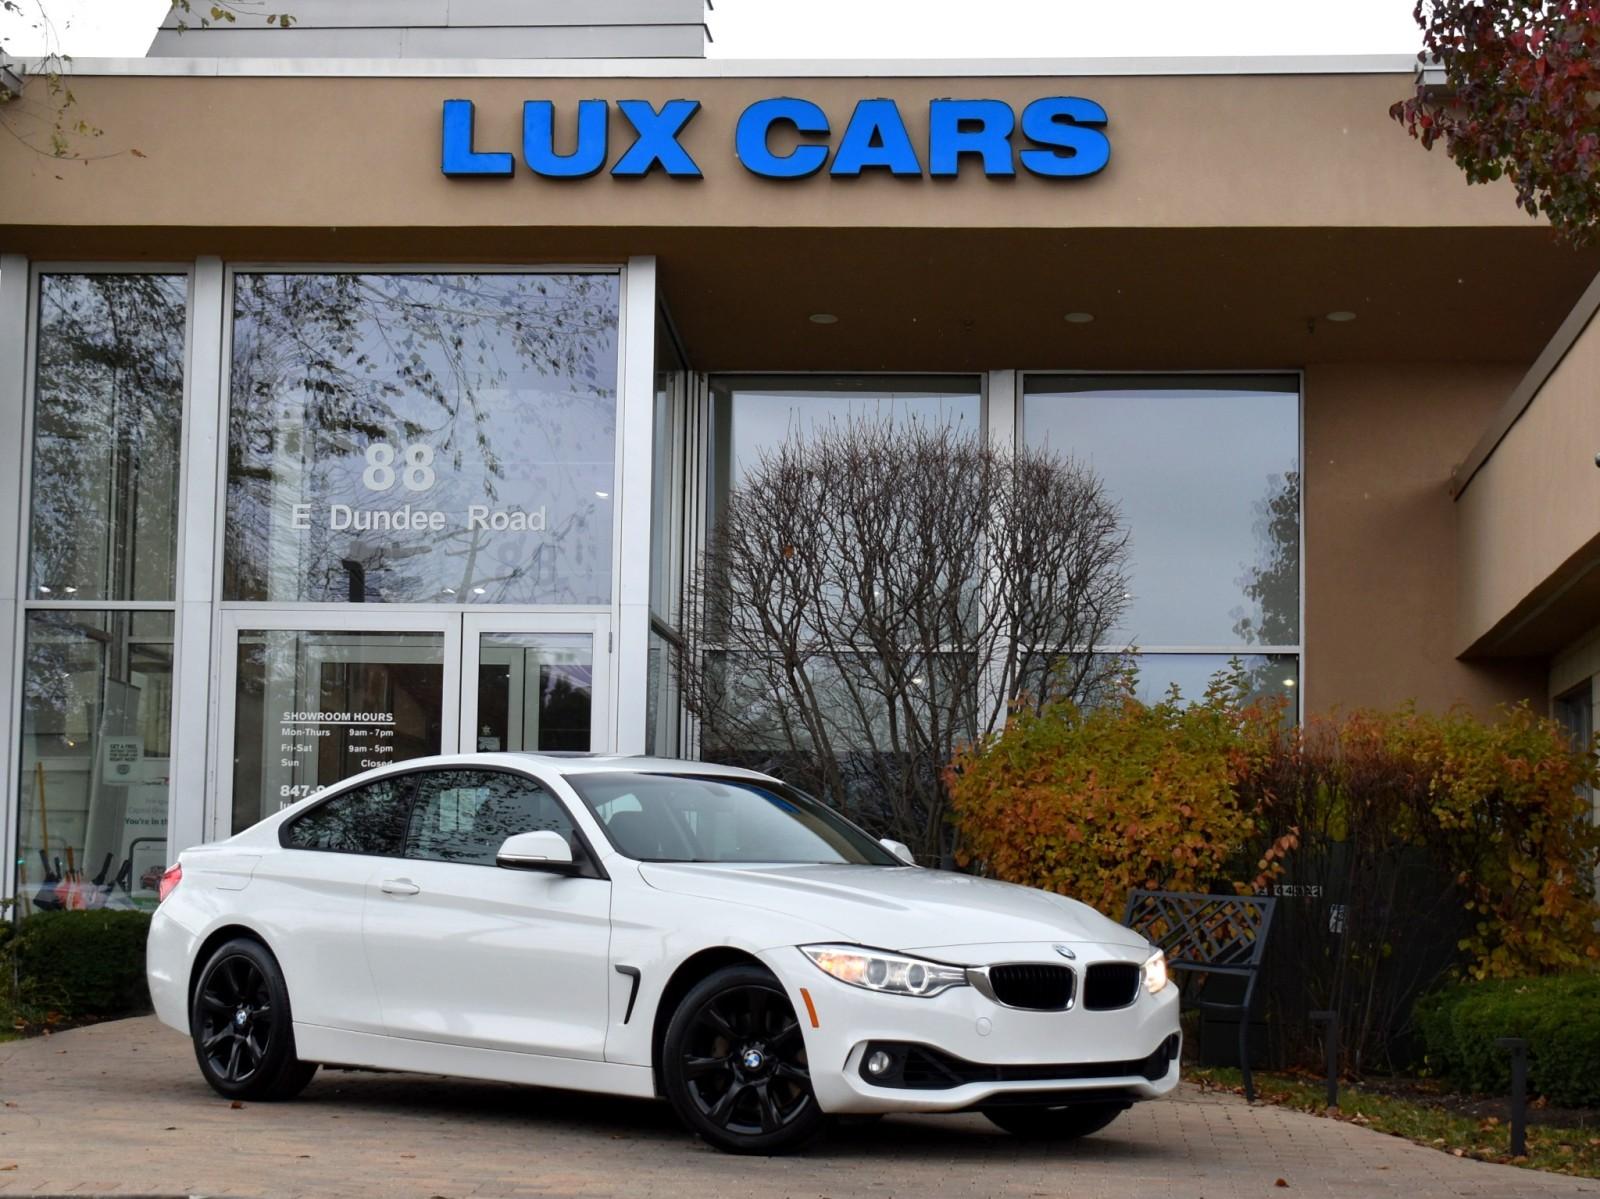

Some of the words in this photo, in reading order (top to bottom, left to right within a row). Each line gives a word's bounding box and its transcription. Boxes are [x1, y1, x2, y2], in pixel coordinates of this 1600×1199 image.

[441, 99, 704, 178] LUX
[734, 97, 1111, 180] CARS
[362, 442, 436, 492] 88
[291, 503, 312, 530] E
[330, 504, 446, 531] Dundee
[468, 504, 546, 531] Road
[283, 711, 351, 721] SHOWROOM
[353, 712, 393, 722] HOURS
[281, 727, 331, 737] Mon-Thurs
[349, 728, 368, 737] 9am
[375, 728, 394, 739] 7pm
[280, 743, 313, 753] Fri-Sat
[348, 744, 367, 753] 9am
[374, 744, 394, 754] 5pm
[281, 758, 300, 768] Sun
